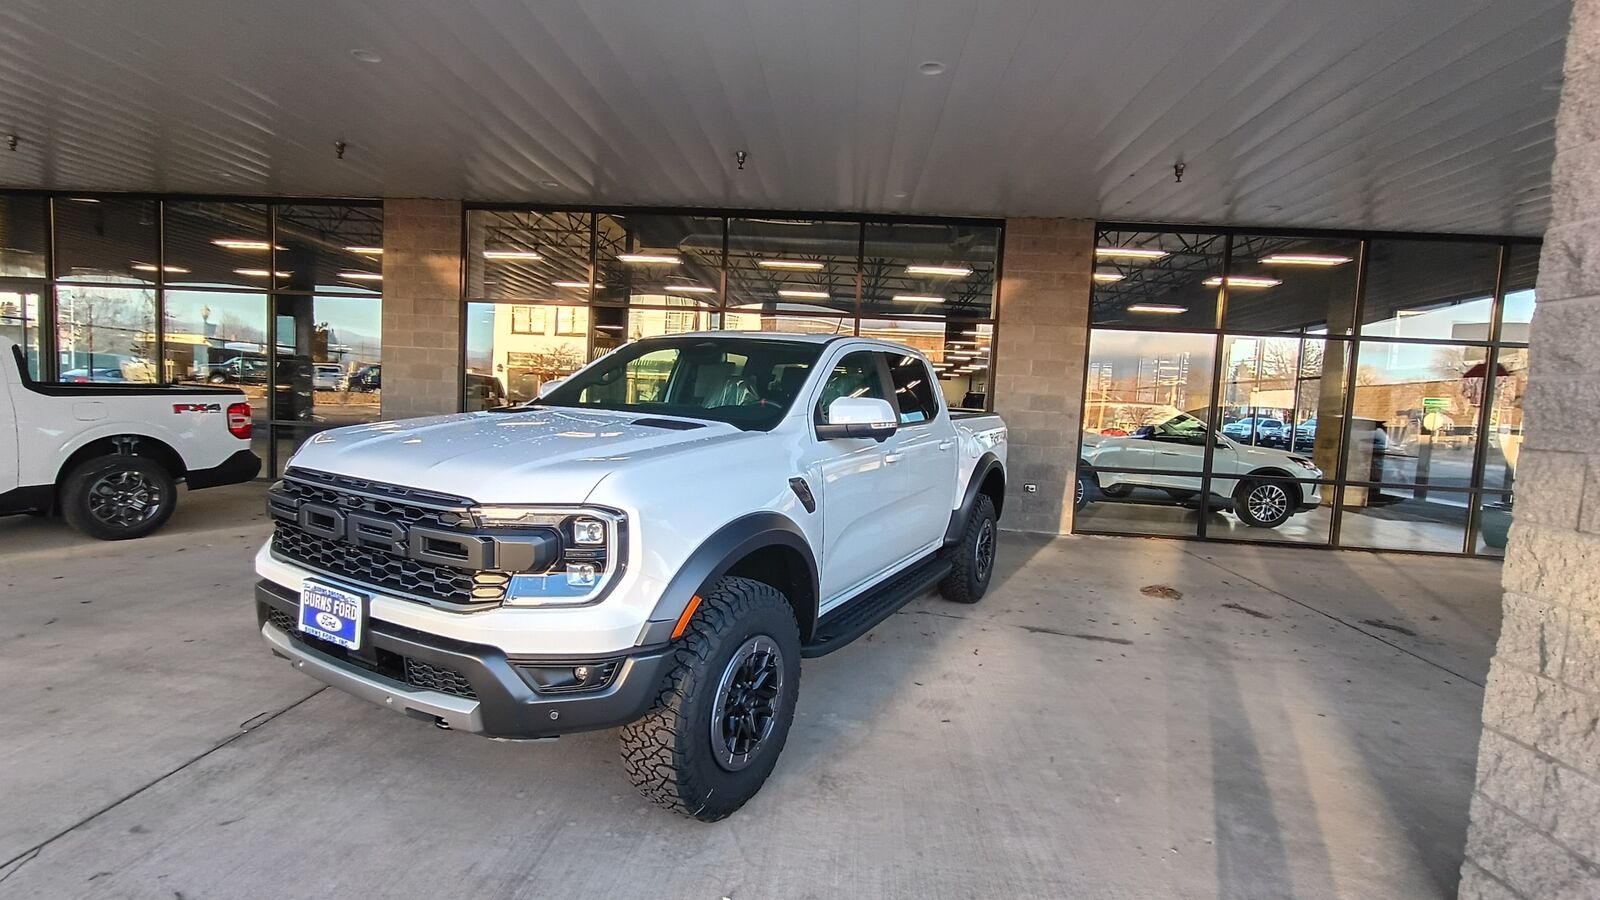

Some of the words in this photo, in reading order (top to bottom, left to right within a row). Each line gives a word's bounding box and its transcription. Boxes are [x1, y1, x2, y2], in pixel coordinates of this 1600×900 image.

[172, 403, 222, 414] FX4
[266, 490, 494, 571] FORD
[304, 590, 332, 612] BURNS
[333, 600, 357, 620] FORD
[320, 614, 337, 628] Ford
